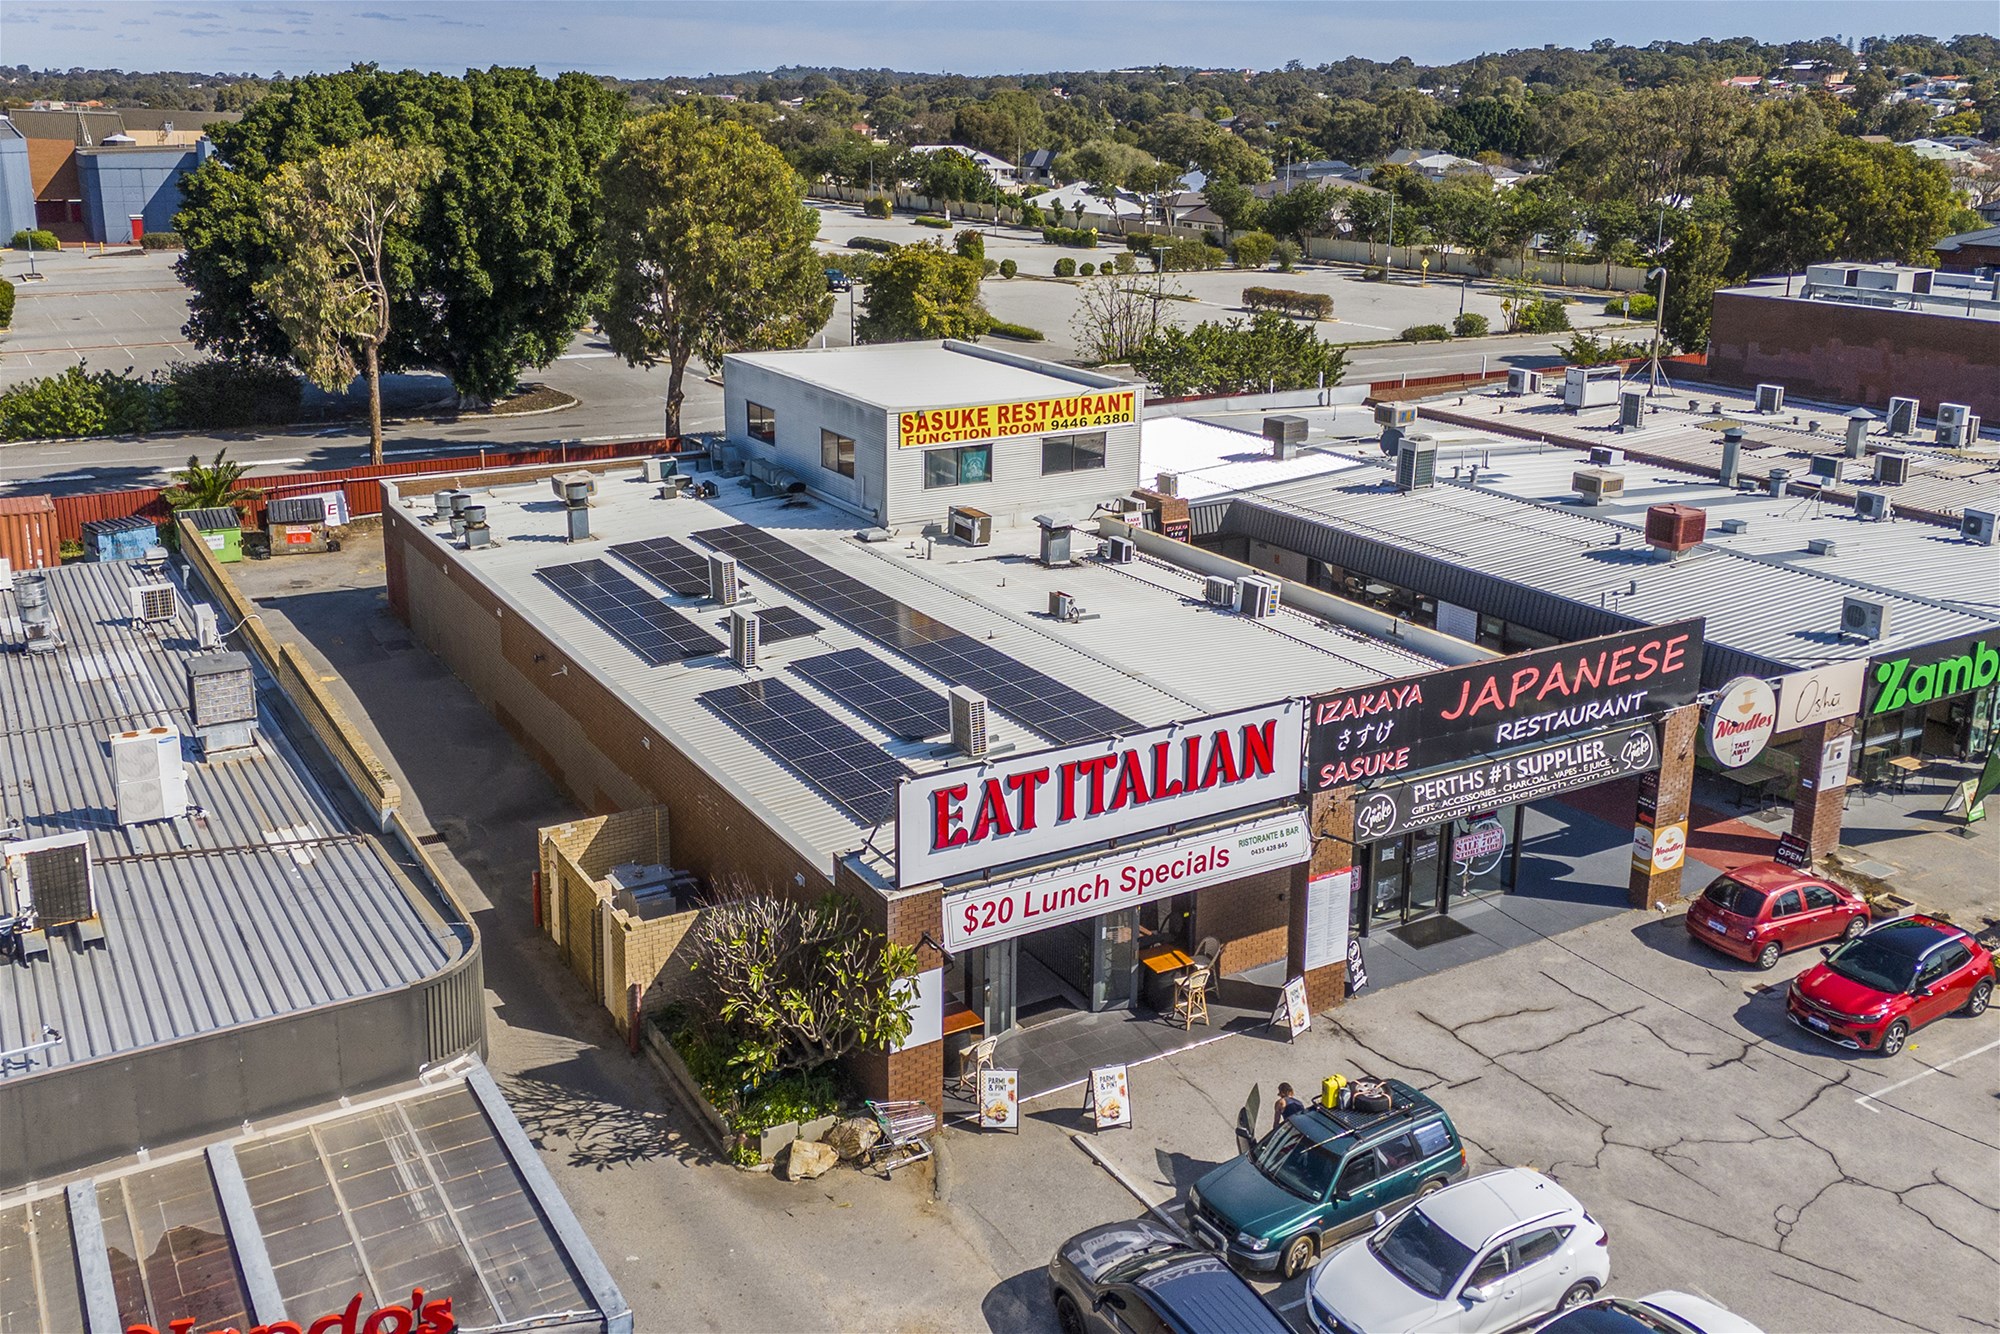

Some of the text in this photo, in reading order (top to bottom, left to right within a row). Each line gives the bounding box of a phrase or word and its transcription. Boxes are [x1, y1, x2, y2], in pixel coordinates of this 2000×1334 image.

[902, 392, 1134, 434] SASUKE RESTAURANT
[905, 412, 1130, 446] FUNCTION ROOM 9446 4380
[1440, 634, 1689, 720] JAPANESE
[1873, 640, 2000, 714] Zamb
[1316, 684, 1423, 726] IZAKAYA
[1496, 691, 1648, 743] RESTAURANT
[1338, 719, 1395, 751] さすけ
[1715, 712, 1773, 740] Noodles
[1734, 740, 1750, 749] TAKE
[1319, 747, 1411, 787] SASUKE
[1414, 740, 1607, 804] PERTHS #1 SUPPLIER
[1731, 747, 1751, 757] AWAY
[932, 718, 1278, 851] EAT ITALIAN
[1402, 767, 1620, 829] www.upinsmokeperth.com.au
[1441, 788, 1497, 808] ACCESSORIES
[1503, 775, 1550, 793] CHARCOAL
[1238, 826, 1300, 848] RISTORANTE & BAR
[1778, 847, 1803, 863] OPEN
[962, 845, 1231, 936] $20 Lunch Specials
